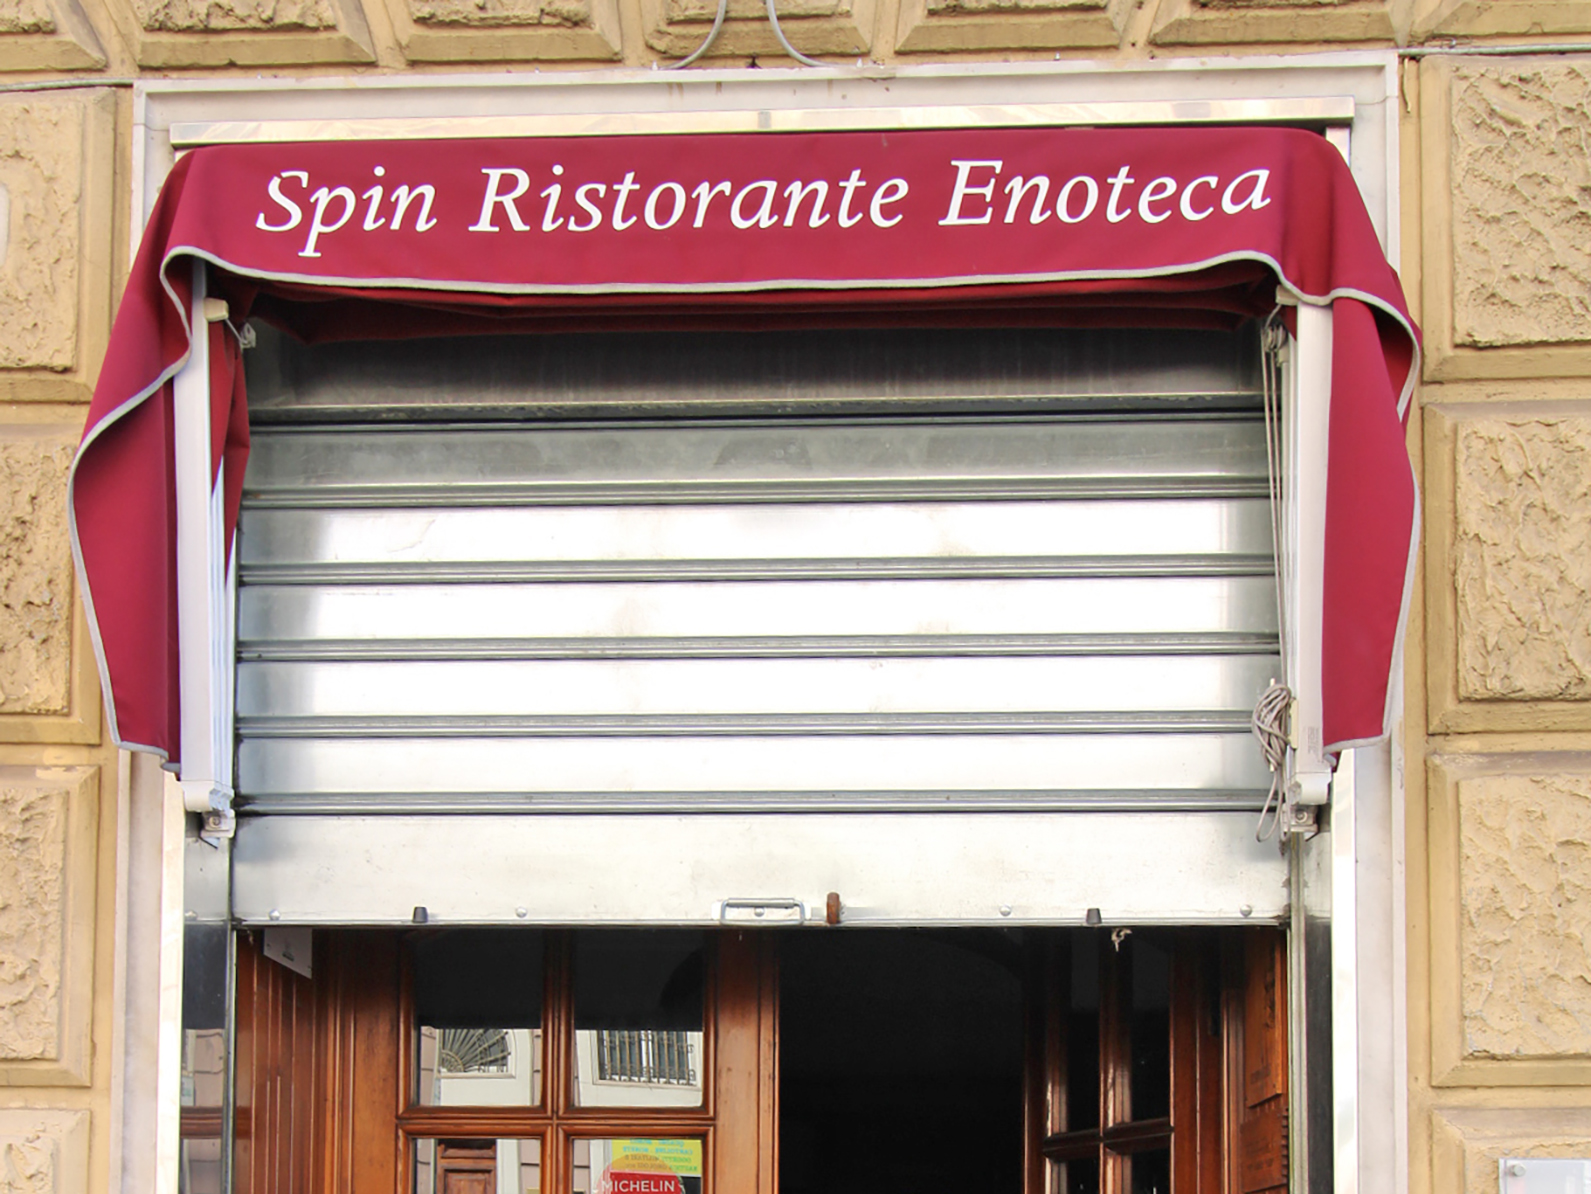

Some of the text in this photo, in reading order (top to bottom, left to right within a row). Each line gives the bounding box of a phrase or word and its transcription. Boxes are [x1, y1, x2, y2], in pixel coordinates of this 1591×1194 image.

[256, 160, 1271, 257] Spin Ristorante Enoteca
[601, 1179, 675, 1193] MICHELIN
